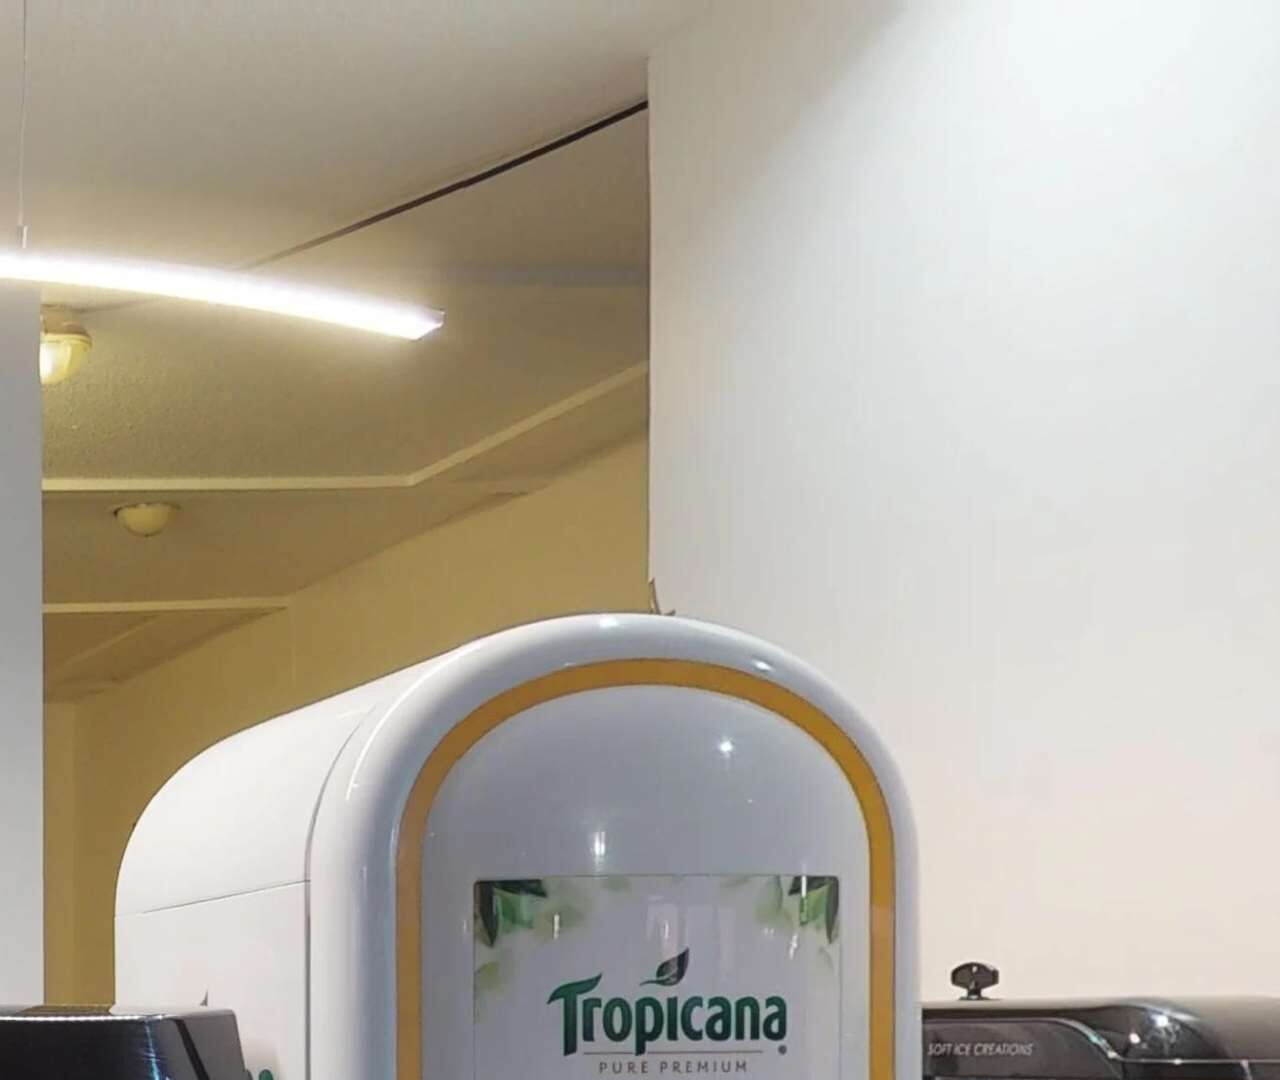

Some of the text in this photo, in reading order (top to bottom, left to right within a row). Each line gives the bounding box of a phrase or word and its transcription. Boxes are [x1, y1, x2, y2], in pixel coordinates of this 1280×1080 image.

[547, 973, 788, 1057] Tropicana
[927, 1043, 1034, 1056] SOFT ICE CREATIONS
[599, 1060, 748, 1074] PURE PREMIUM
